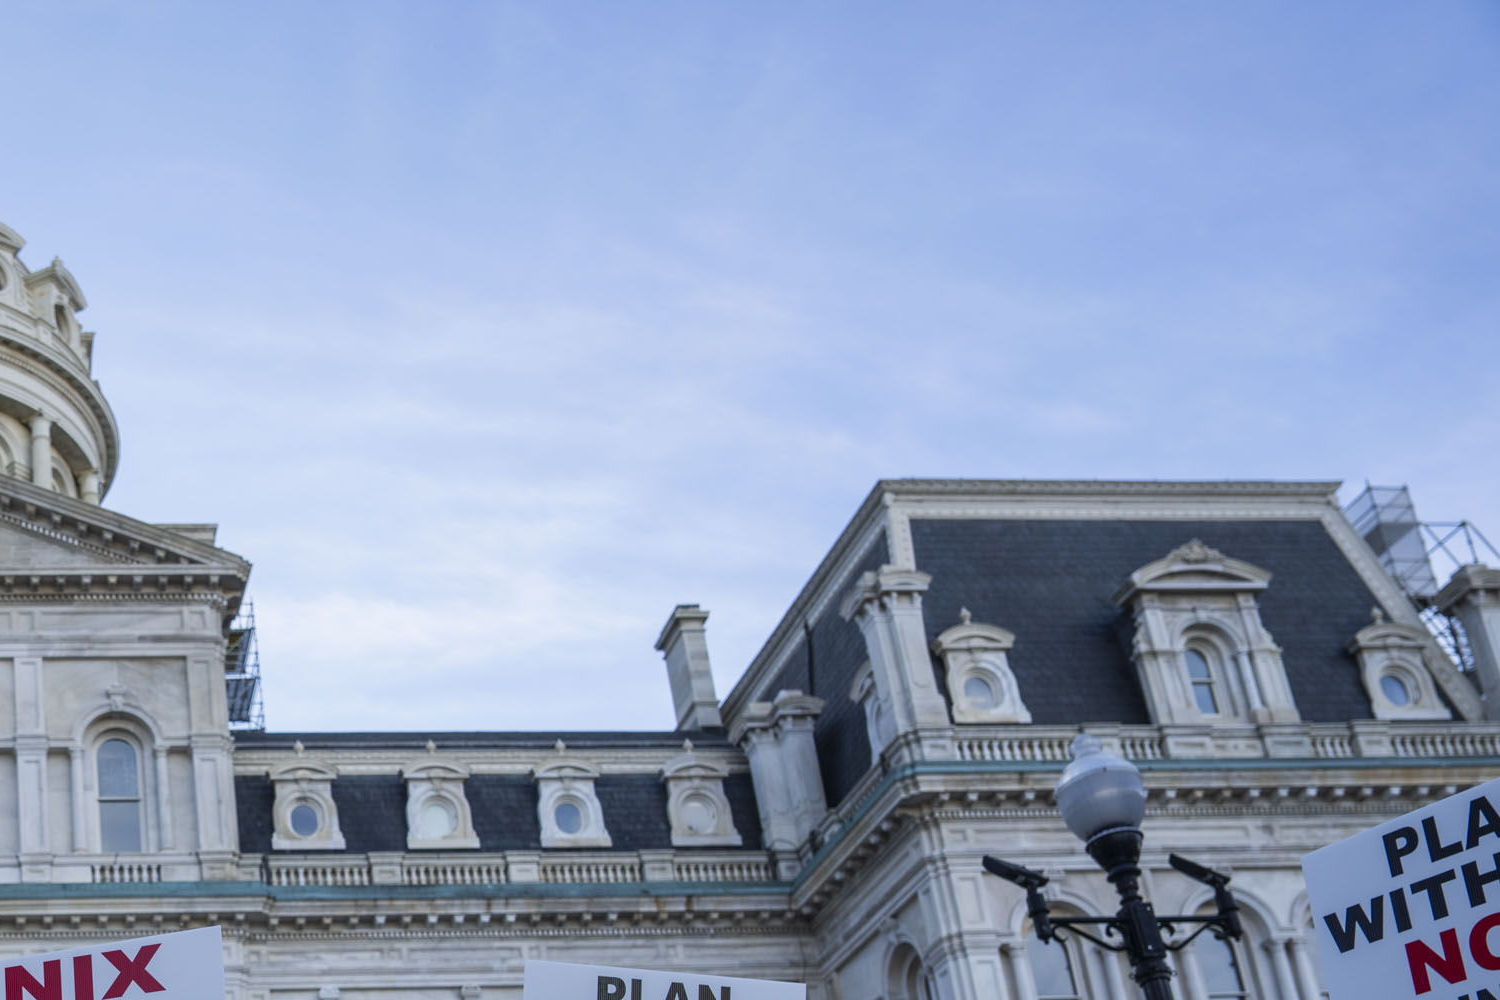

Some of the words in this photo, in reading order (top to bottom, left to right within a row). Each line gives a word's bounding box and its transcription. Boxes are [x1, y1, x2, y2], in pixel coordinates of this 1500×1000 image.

[1382, 796, 1500, 877] PLA
[1323, 852, 1500, 953] WITH
[1405, 912, 1500, 995] NO
